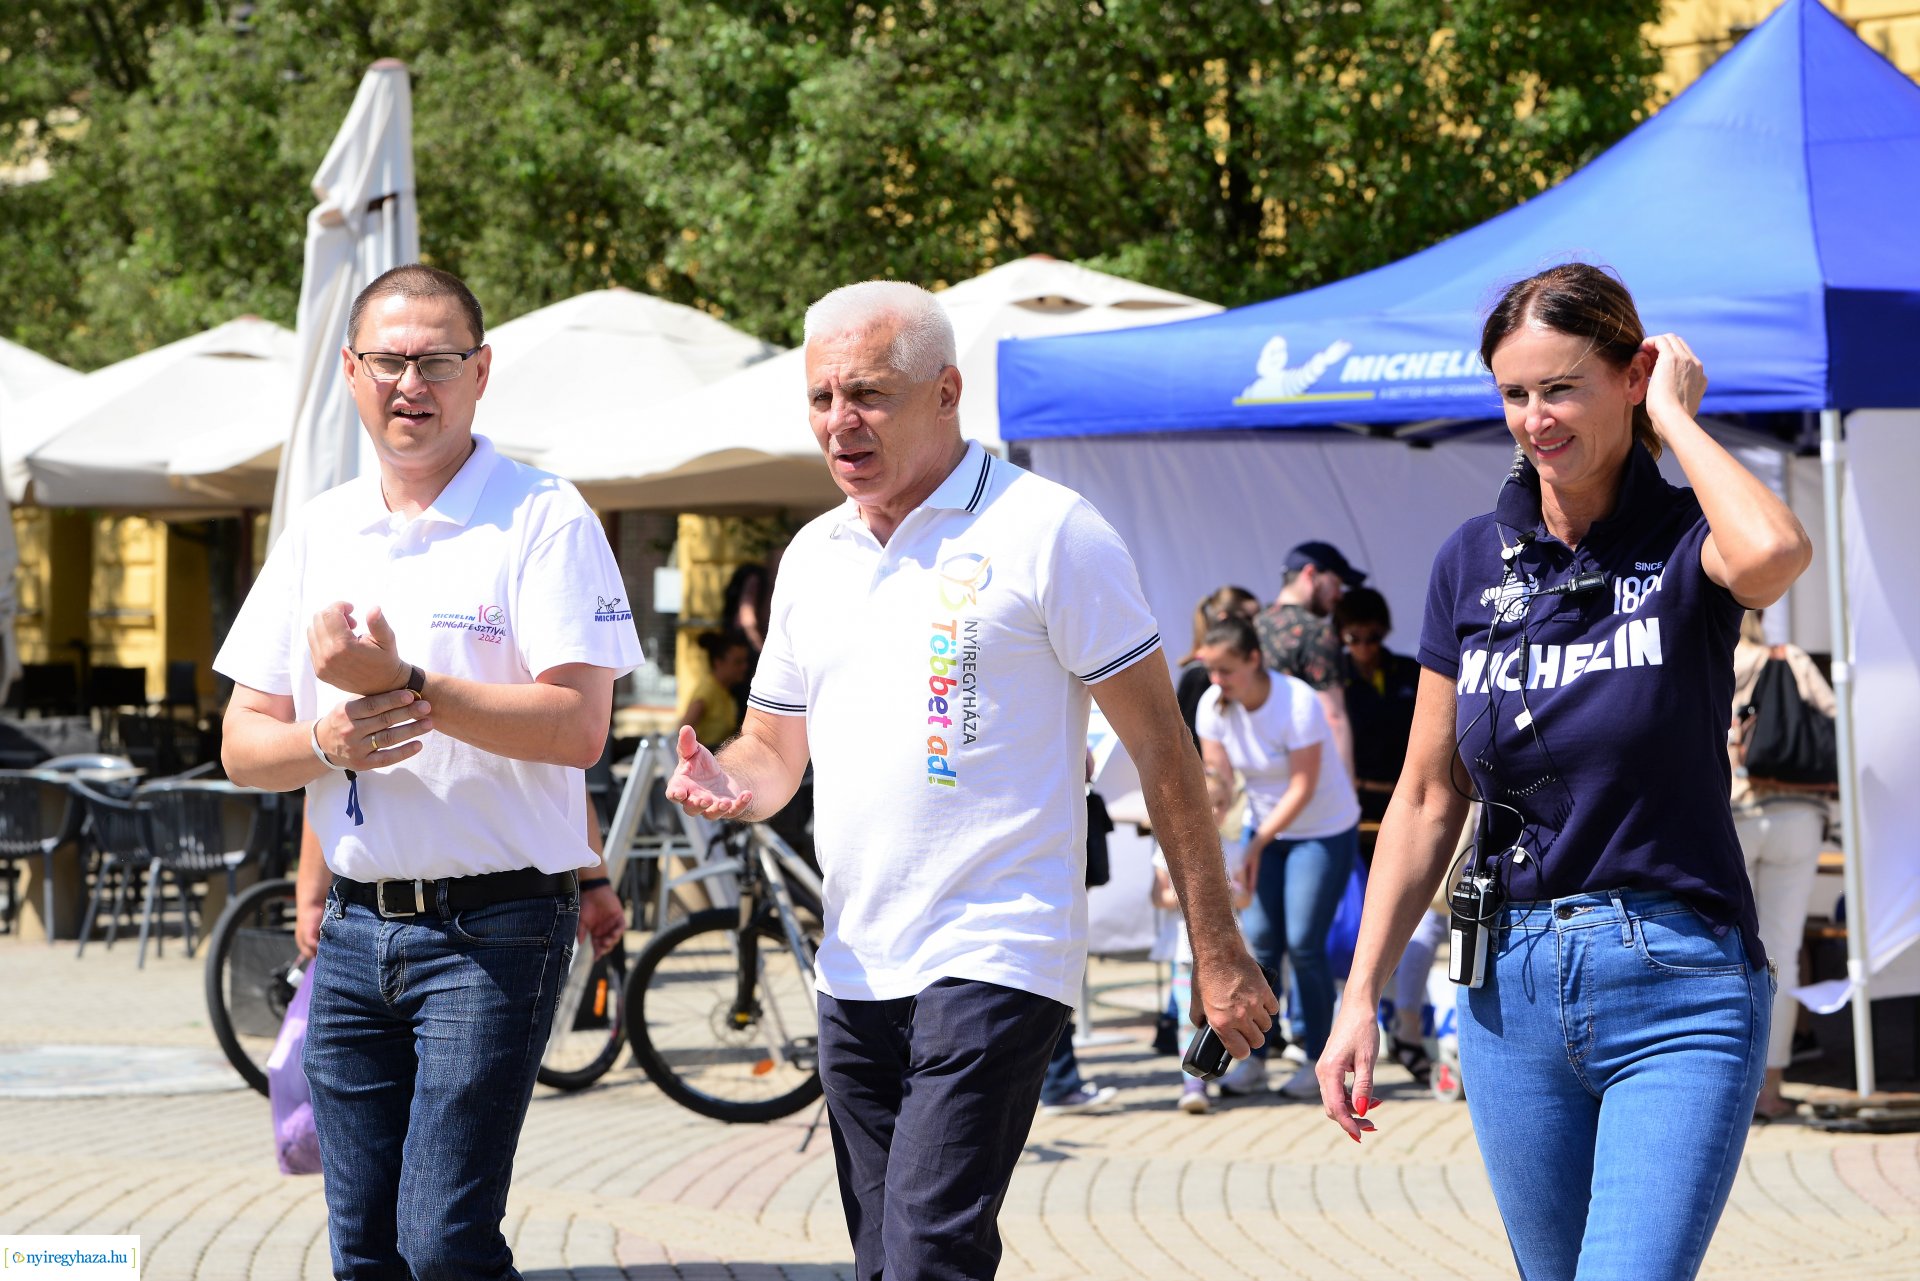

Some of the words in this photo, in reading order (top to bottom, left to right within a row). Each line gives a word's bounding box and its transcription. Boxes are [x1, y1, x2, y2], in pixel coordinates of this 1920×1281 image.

[1634, 561, 1663, 571] SINCE
[432, 613, 476, 621] MICHELIN
[594, 613, 632, 622] MICHLIN
[478, 633, 502, 644] 2022
[1457, 617, 1663, 696] MICHELIN
[928, 619, 958, 729] Többet
[962, 619, 981, 746] NYÍREGYHÁZA
[927, 735, 957, 788] ad!
